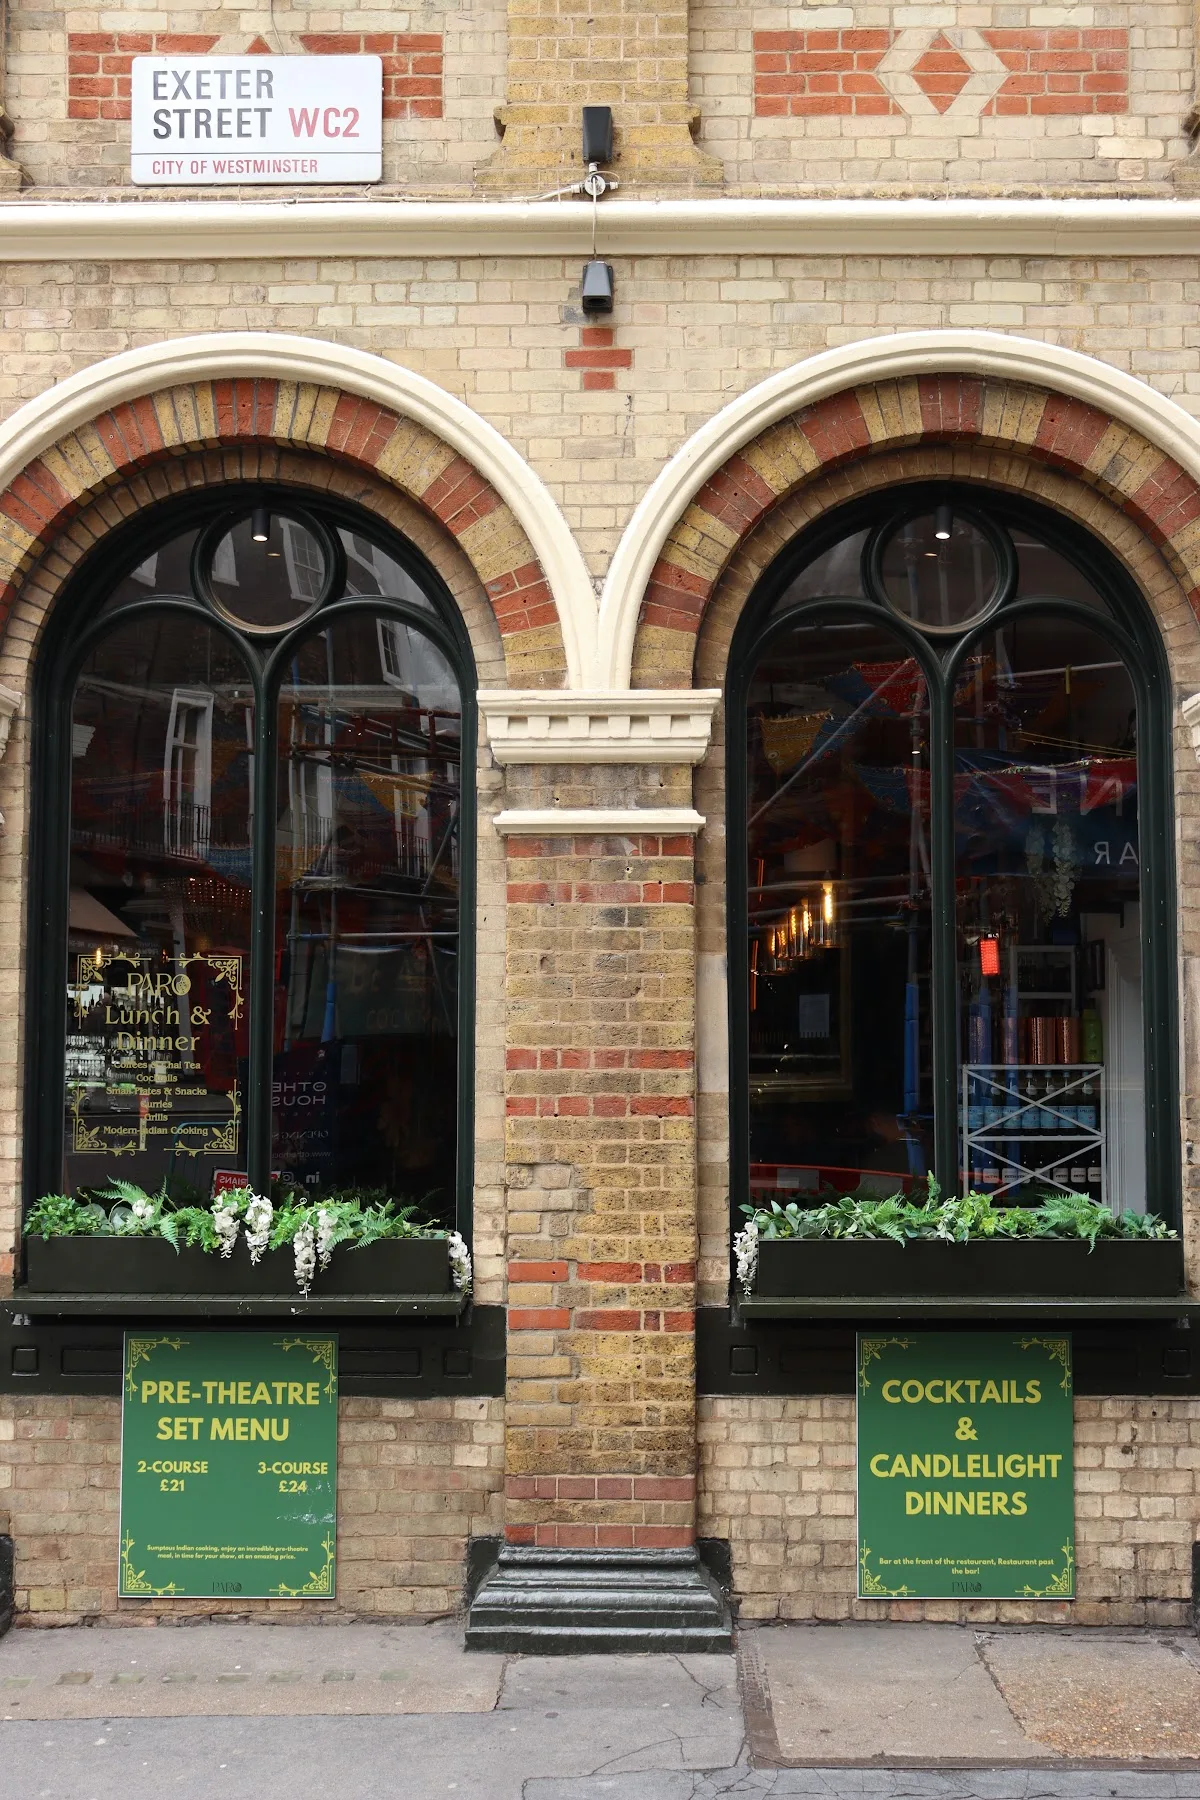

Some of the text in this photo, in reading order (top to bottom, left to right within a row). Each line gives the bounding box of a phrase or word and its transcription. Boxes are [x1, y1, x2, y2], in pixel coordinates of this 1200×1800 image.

[152, 69, 273, 100] EXETER
[153, 107, 360, 139] STREET WC2
[152, 159, 318, 175] CITY OF WESTMINSTER
[127, 972, 192, 996] PARO
[105, 1005, 211, 1025] Lunch &
[117, 1032, 200, 1051] Dinner
[114, 1061, 148, 1069] Coffees
[160, 1061, 182, 1069] Chai
[184, 1061, 201, 1069] Tea
[136, 1074, 178, 1082] Cocktails
[106, 1087, 207, 1096] Small Plates & Snacks
[140, 1100, 173, 1109] Curries
[144, 1113, 168, 1121] Grills
[171, 1126, 208, 1137] Cooking
[141, 1381, 320, 1405] PRE-THEATRE
[882, 1379, 1042, 1404] COCKTAILS
[156, 1417, 289, 1441] SET MENU
[955, 1417, 978, 1441] &
[137, 1461, 208, 1474] 2-COURSE
[257, 1461, 328, 1474] 3-COURSE
[869, 1454, 1062, 1478] CANDLELIGHT
[160, 1479, 185, 1492] £21
[278, 1480, 307, 1493] £24
[905, 1491, 1028, 1516] DINNERS
[221, 1545, 237, 1553] enjoy
[879, 1557, 1054, 1566] Bar at the front of the restaurant, Restaurant past
[952, 1567, 980, 1575] the bar!
[212, 1582, 242, 1593] PARO
